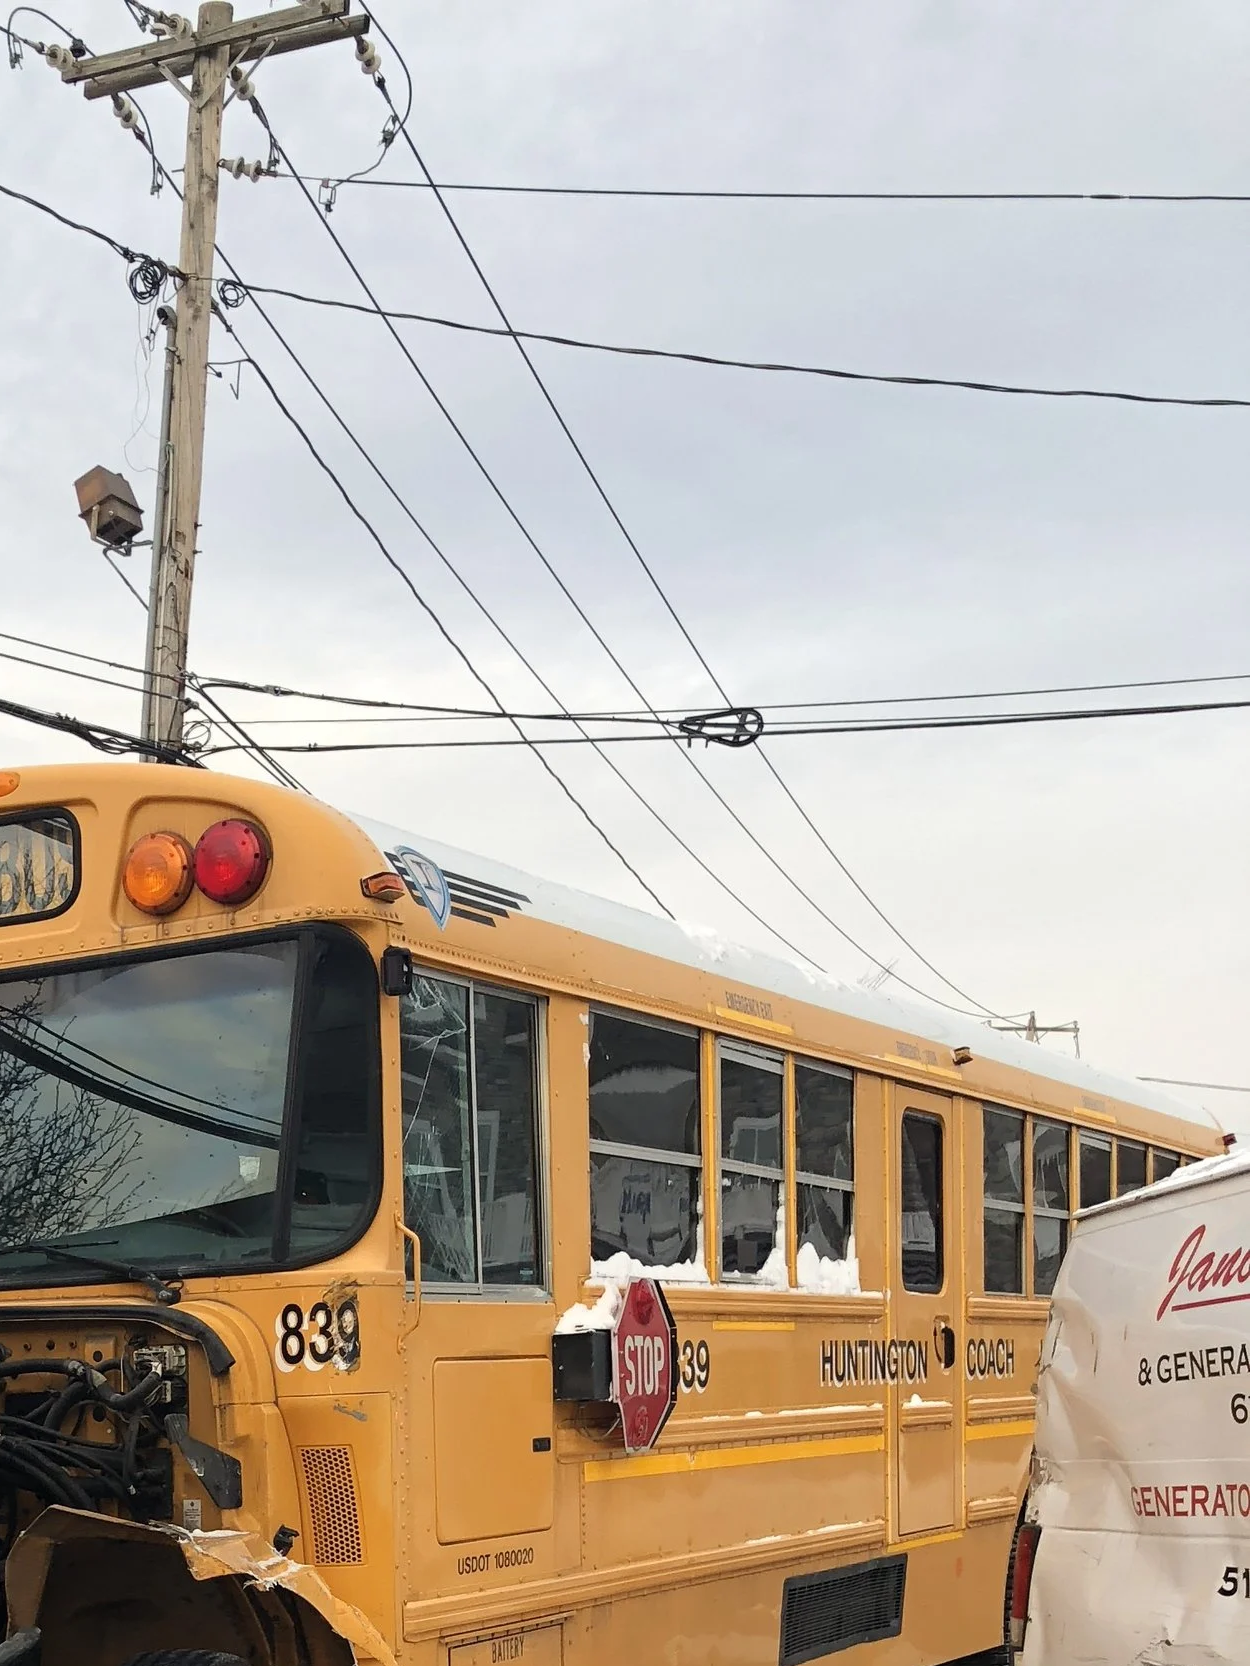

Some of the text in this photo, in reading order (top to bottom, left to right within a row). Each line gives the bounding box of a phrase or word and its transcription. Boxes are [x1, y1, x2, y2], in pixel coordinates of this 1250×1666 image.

[276, 1301, 360, 1372] 839
[624, 1334, 665, 1396] STOP
[675, 1340, 711, 1393] 39
[820, 1338, 1015, 1387] HUNTINGTON COACH
[1138, 1357, 1152, 1386] &
[1231, 1393, 1250, 1424] 6
[457, 1547, 534, 1575] USDOT 1080020
[491, 1634, 525, 1664] BATTERY
